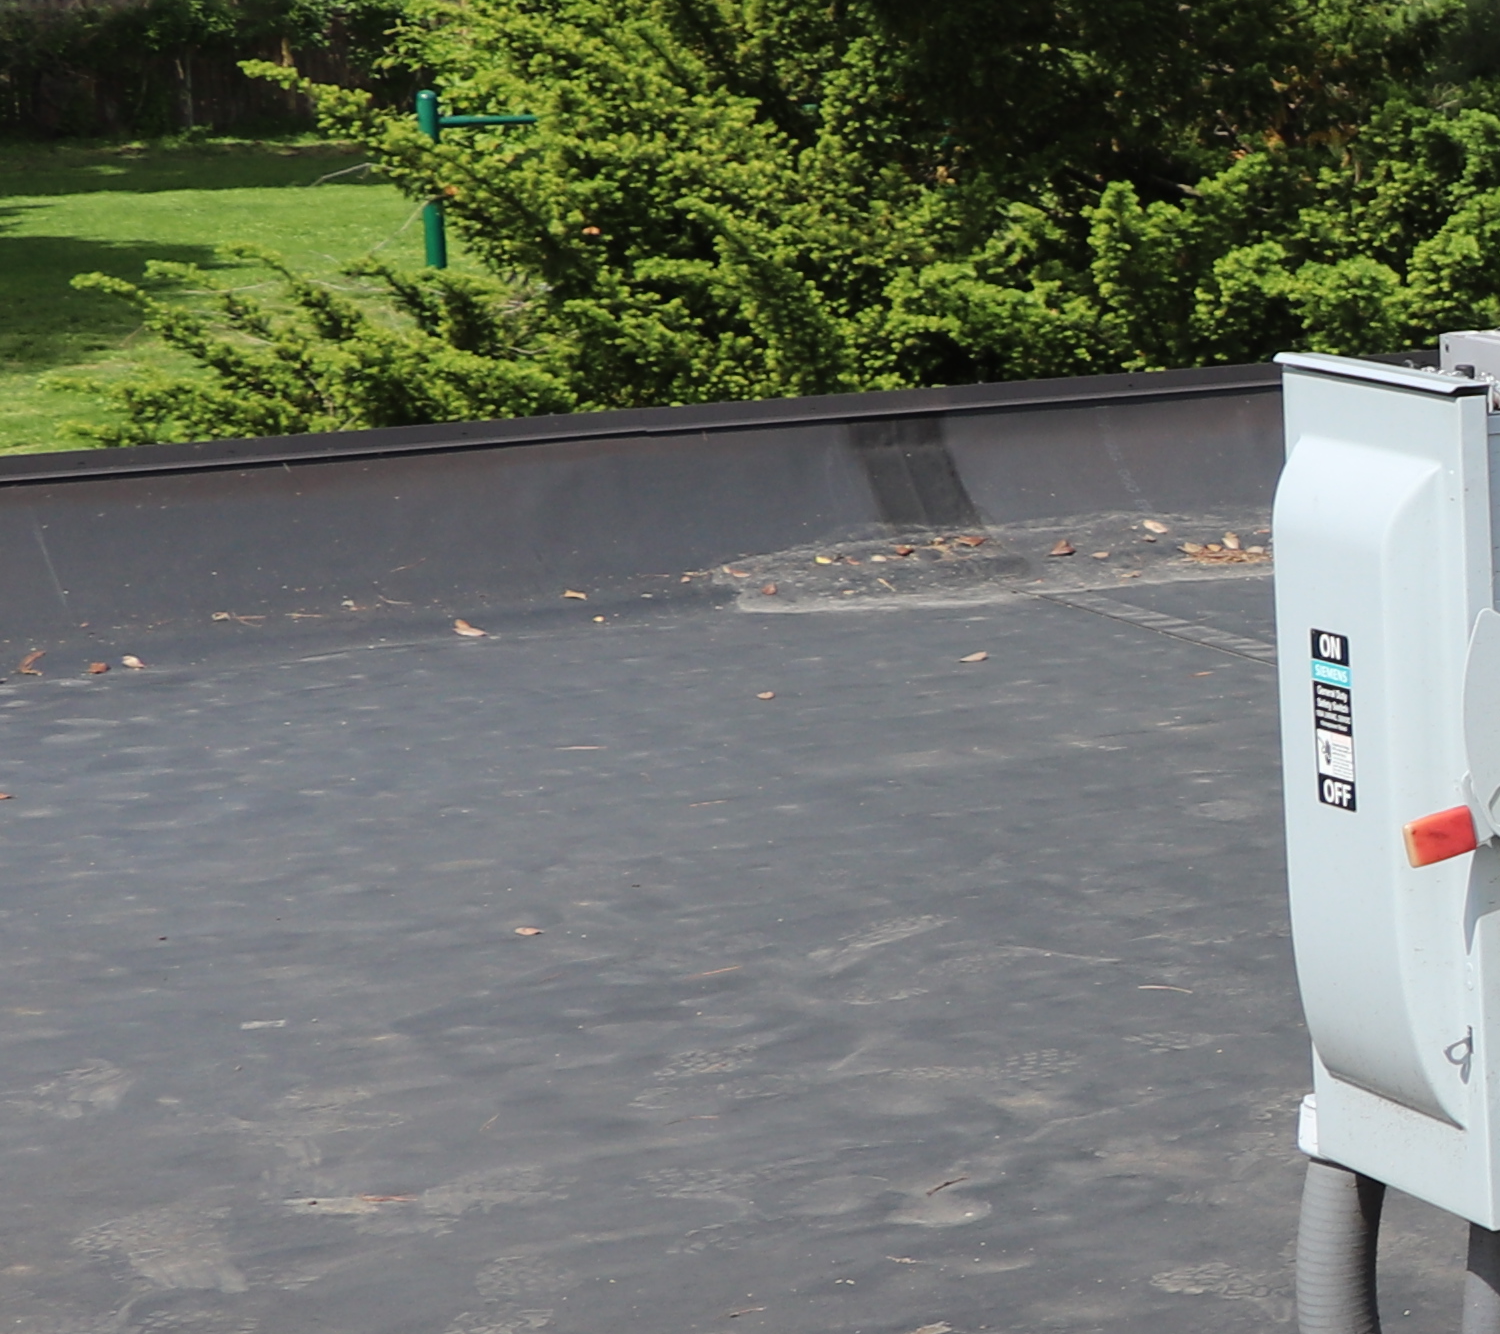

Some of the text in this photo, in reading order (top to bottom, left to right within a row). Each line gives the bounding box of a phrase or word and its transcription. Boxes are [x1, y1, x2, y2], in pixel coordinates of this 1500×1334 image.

[1319, 632, 1342, 661] ON
[1314, 663, 1348, 684] SIEMENS
[1322, 778, 1353, 808] OFF
